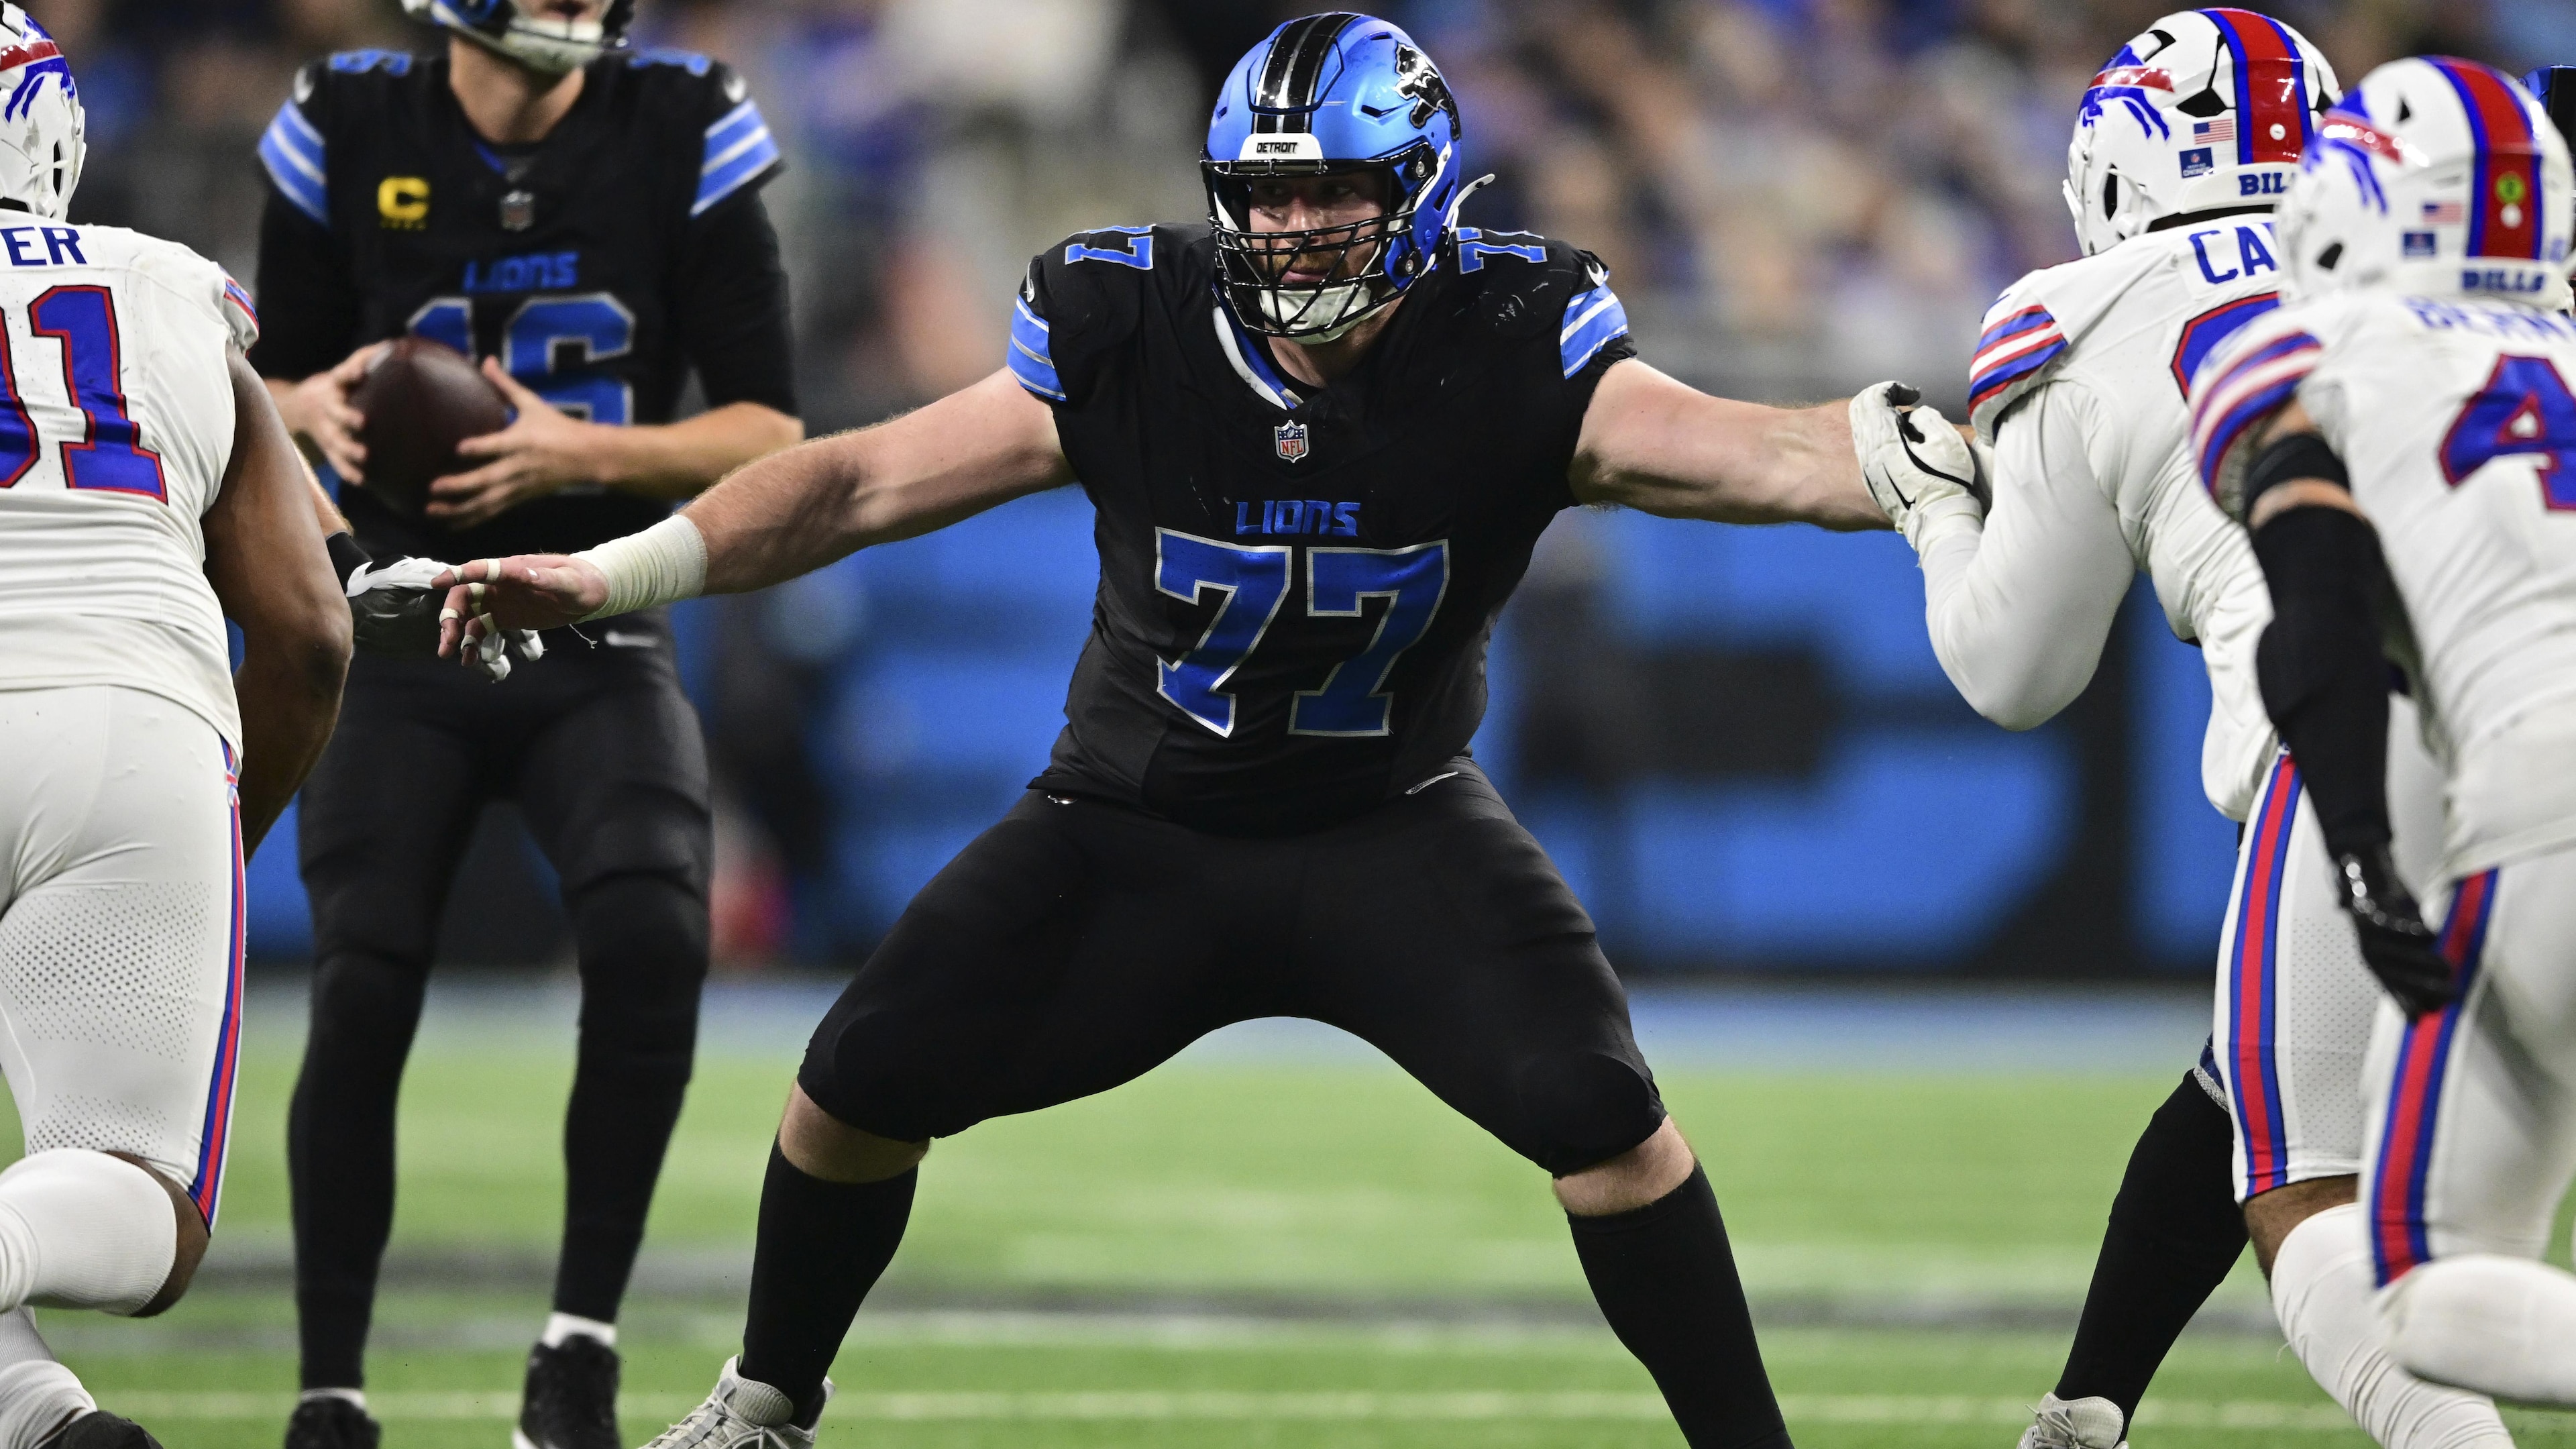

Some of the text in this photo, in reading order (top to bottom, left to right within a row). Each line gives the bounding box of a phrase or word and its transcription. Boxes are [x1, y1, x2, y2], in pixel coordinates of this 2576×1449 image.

[1256, 142, 1298, 154] DETROIT
[2238, 172, 2295, 196] BIL
[2188, 222, 2276, 284] CA
[0, 284, 169, 506] 1
[1281, 439, 1303, 455] NFL
[1236, 500, 1360, 537] LIONS
[1155, 526, 1449, 738] 77
